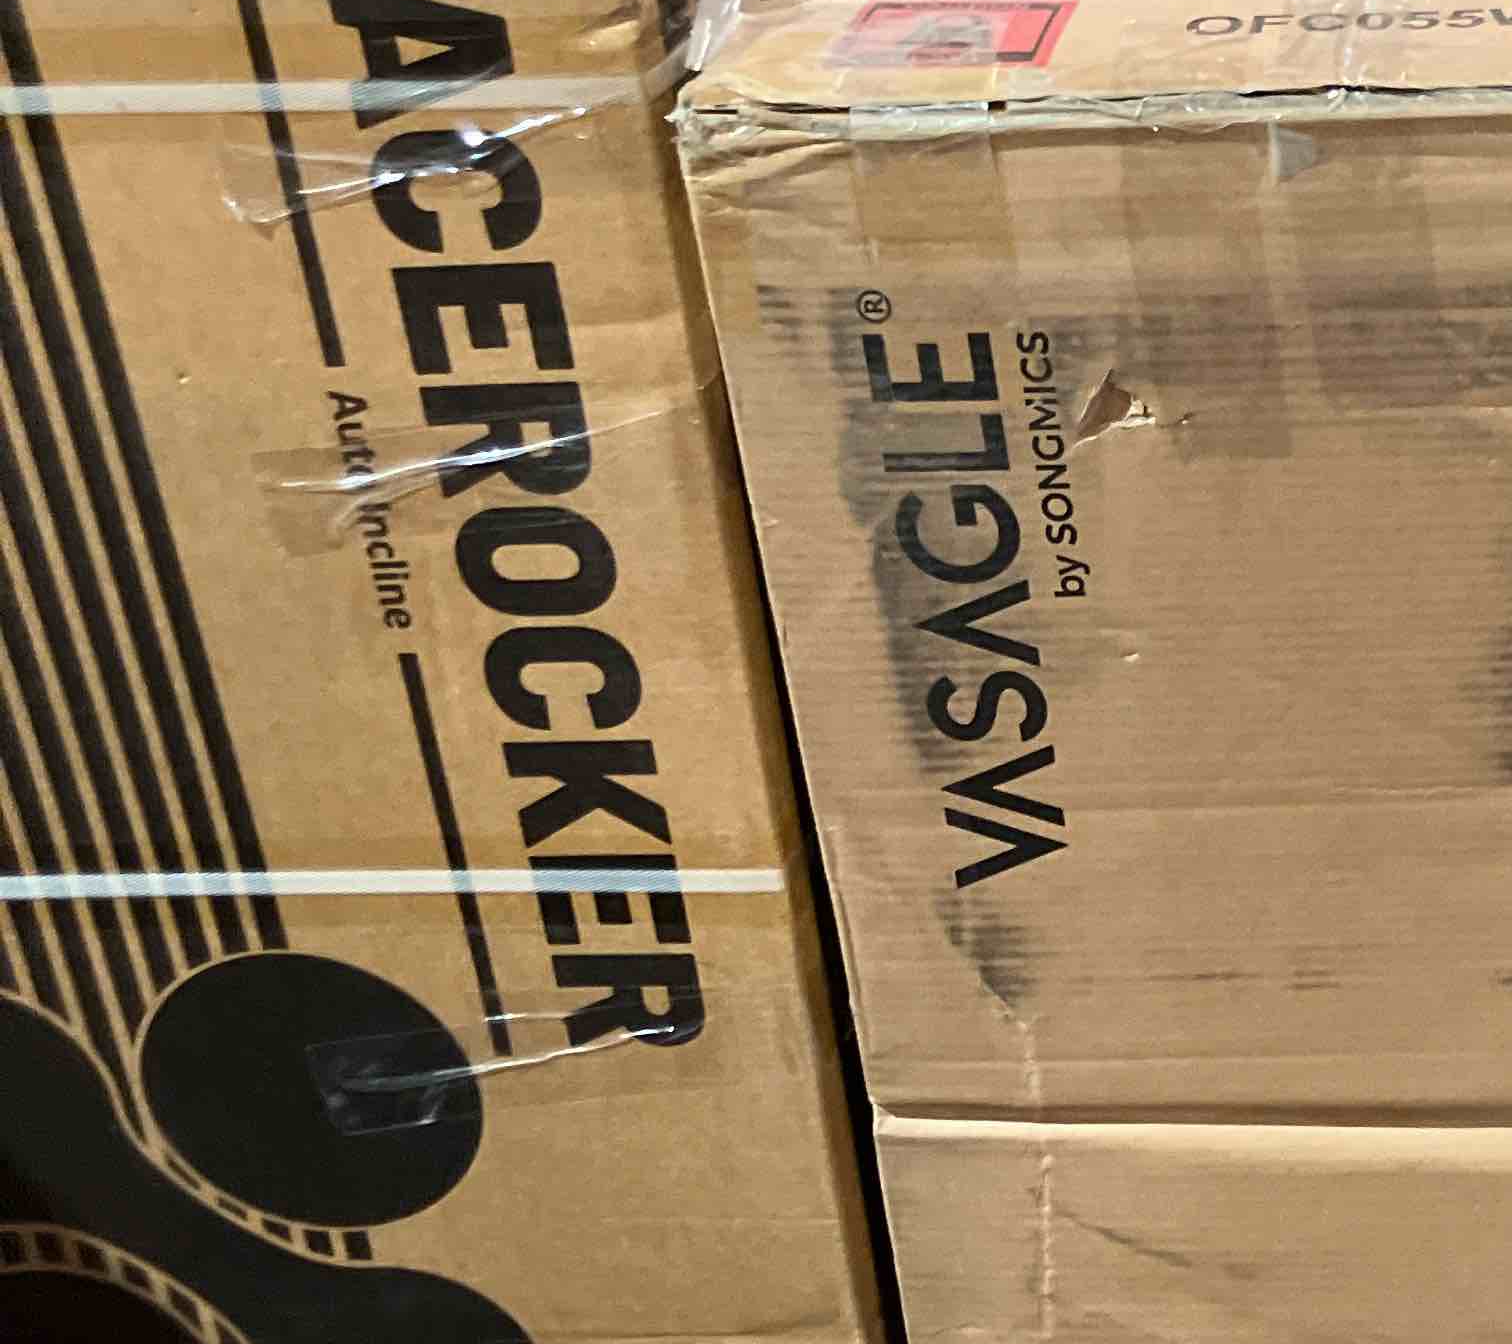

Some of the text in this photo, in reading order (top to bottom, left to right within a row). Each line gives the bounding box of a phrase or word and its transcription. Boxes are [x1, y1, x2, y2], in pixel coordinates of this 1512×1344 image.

[326, 391, 412, 630] Auto Incline
[1016, 330, 1090, 599] by SONGMICS
[861, 331, 1069, 889] VASAGLE
